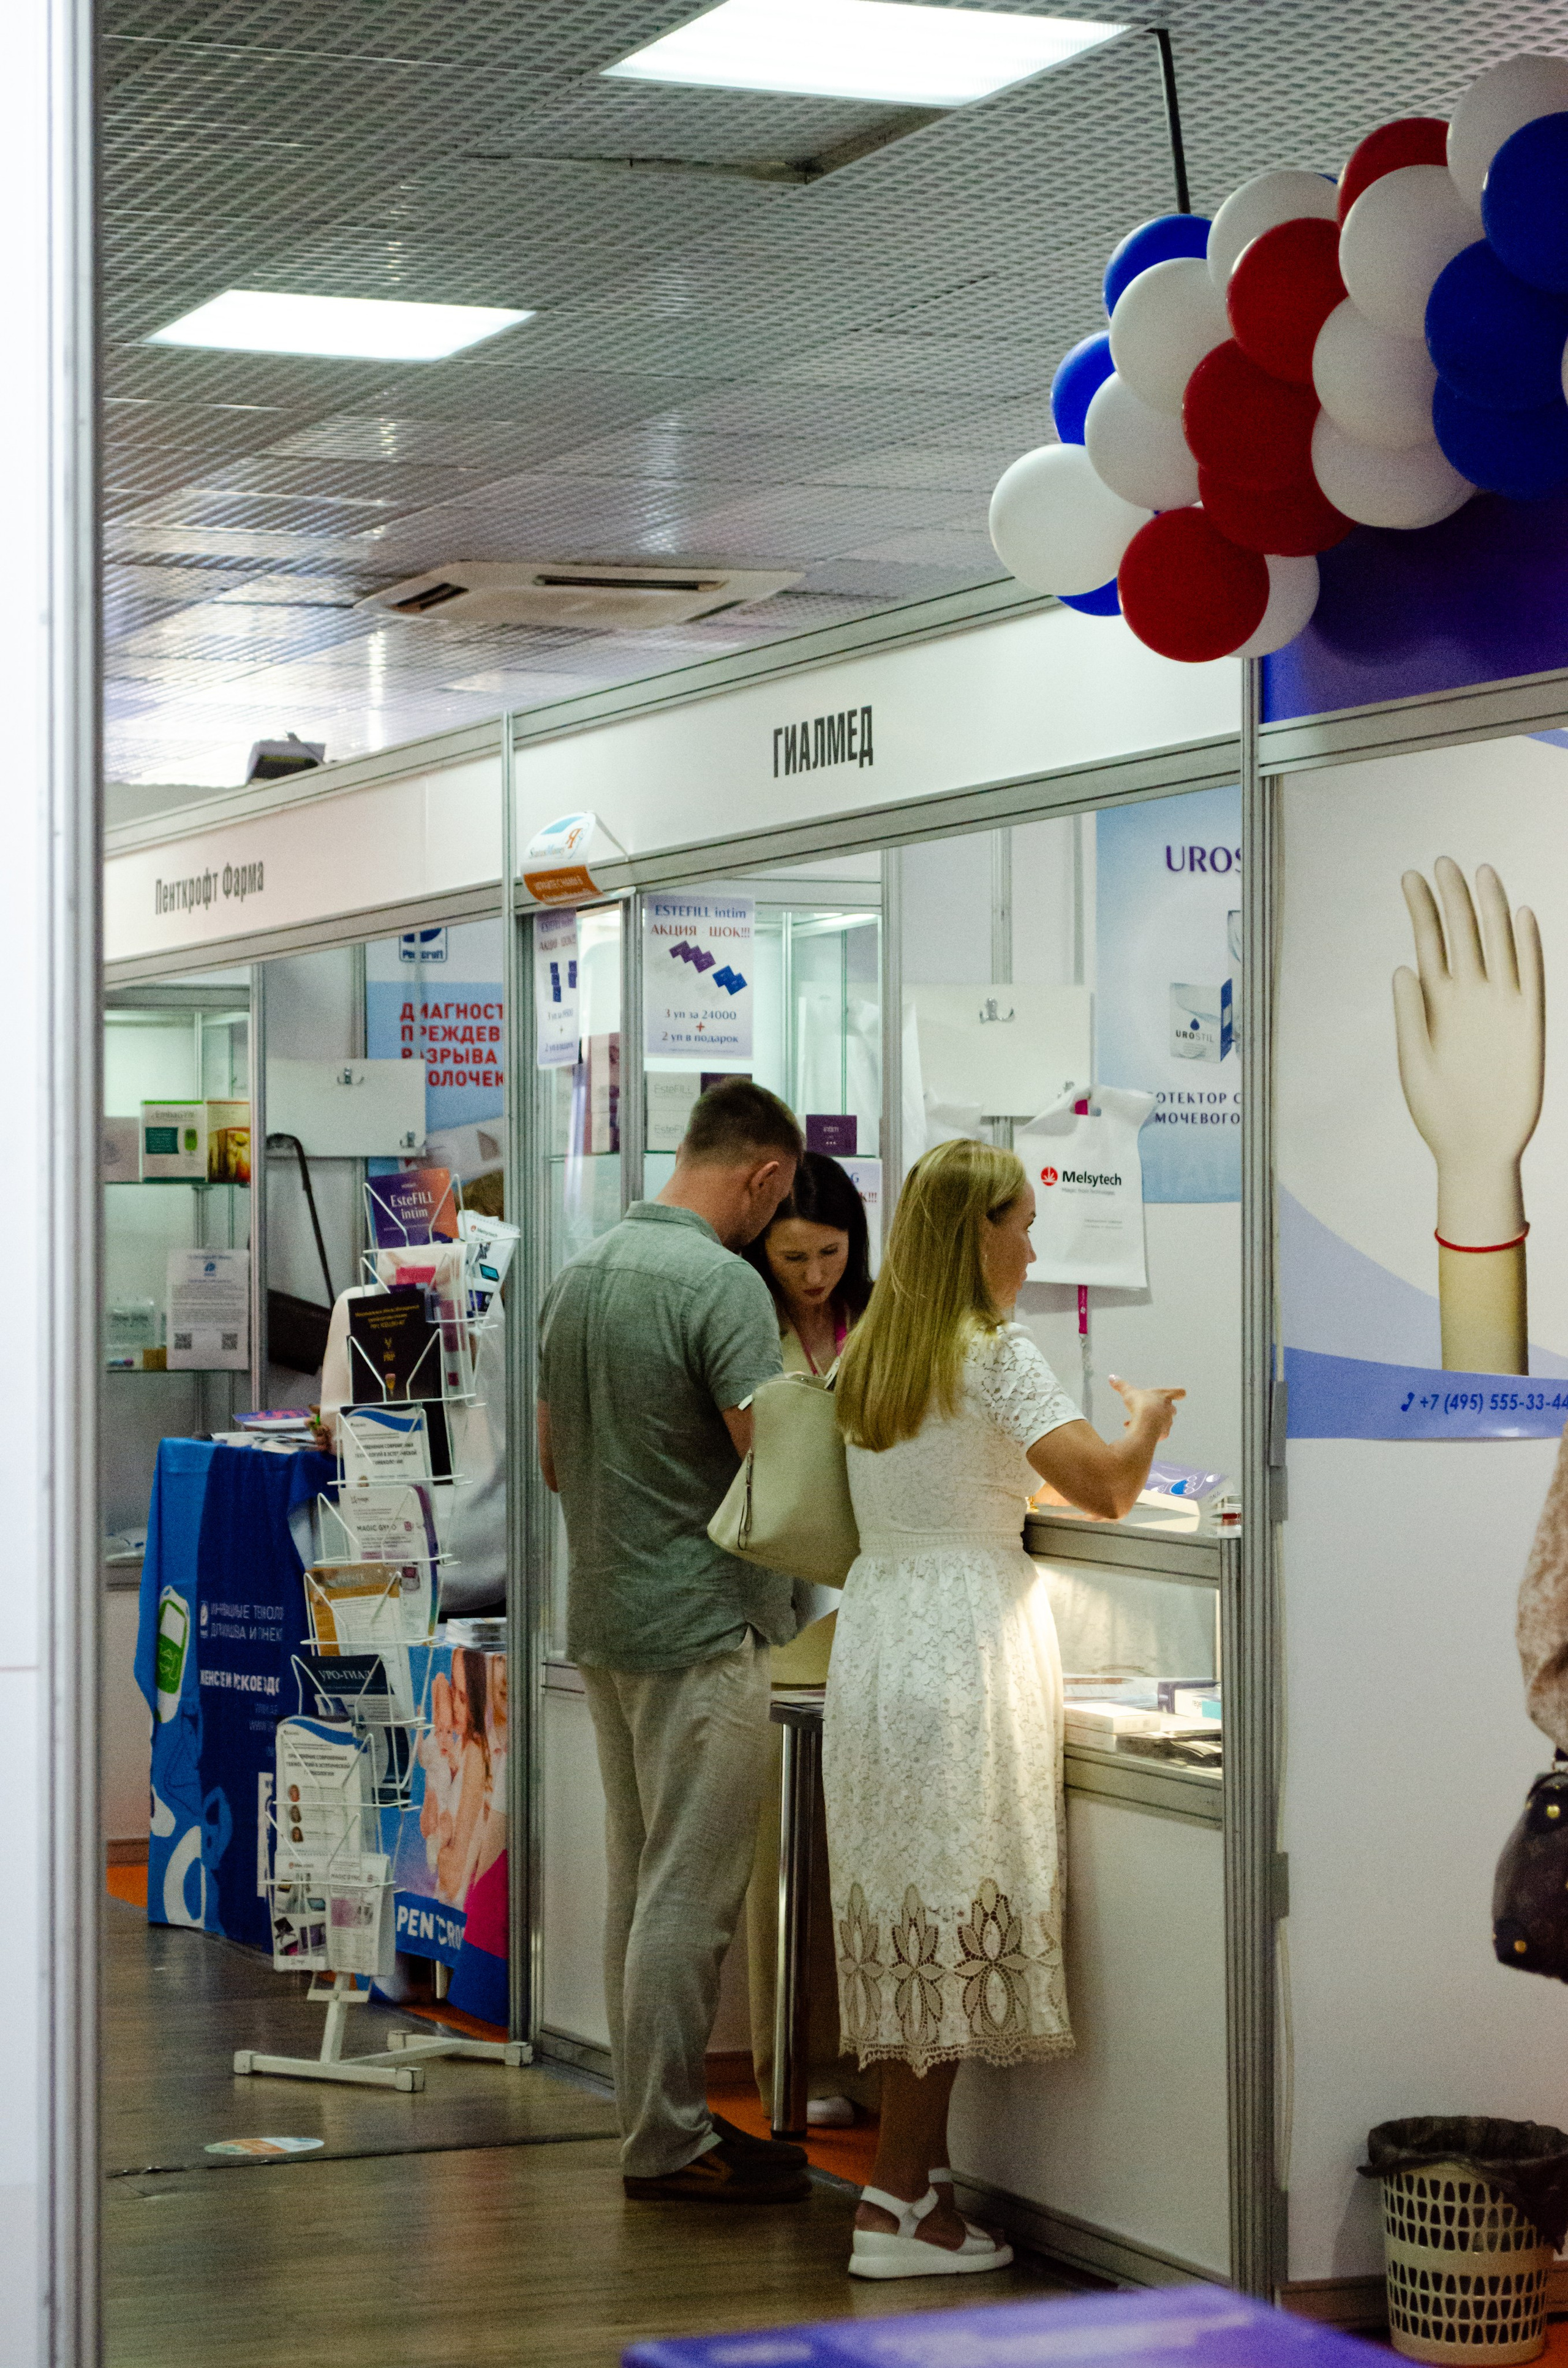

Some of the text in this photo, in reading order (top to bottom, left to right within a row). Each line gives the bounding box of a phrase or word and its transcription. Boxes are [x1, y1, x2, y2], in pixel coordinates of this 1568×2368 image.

[774, 705, 873, 778] ГИАЛМЕД
[155, 860, 264, 915] Пенткрофт Фарма
[655, 904, 747, 918] ESTEFILL intim
[650, 924, 697, 937] АКЦИЯ
[709, 926, 750, 938] ШОК!!!
[665, 1008, 671, 1018] 3
[702, 1010, 737, 1020] 24000
[662, 1032, 668, 1040] 2
[695, 1035, 739, 1044] подарок
[1155, 1112, 1240, 1124] МОЧЕВОГО
[1062, 1171, 1122, 1187] Melsytech
[390, 1191, 435, 1208] EsteFILL
[401, 1208, 428, 1220] intim
[1419, 1394, 1439, 1410] +7
[1444, 1393, 1483, 1415] (495)
